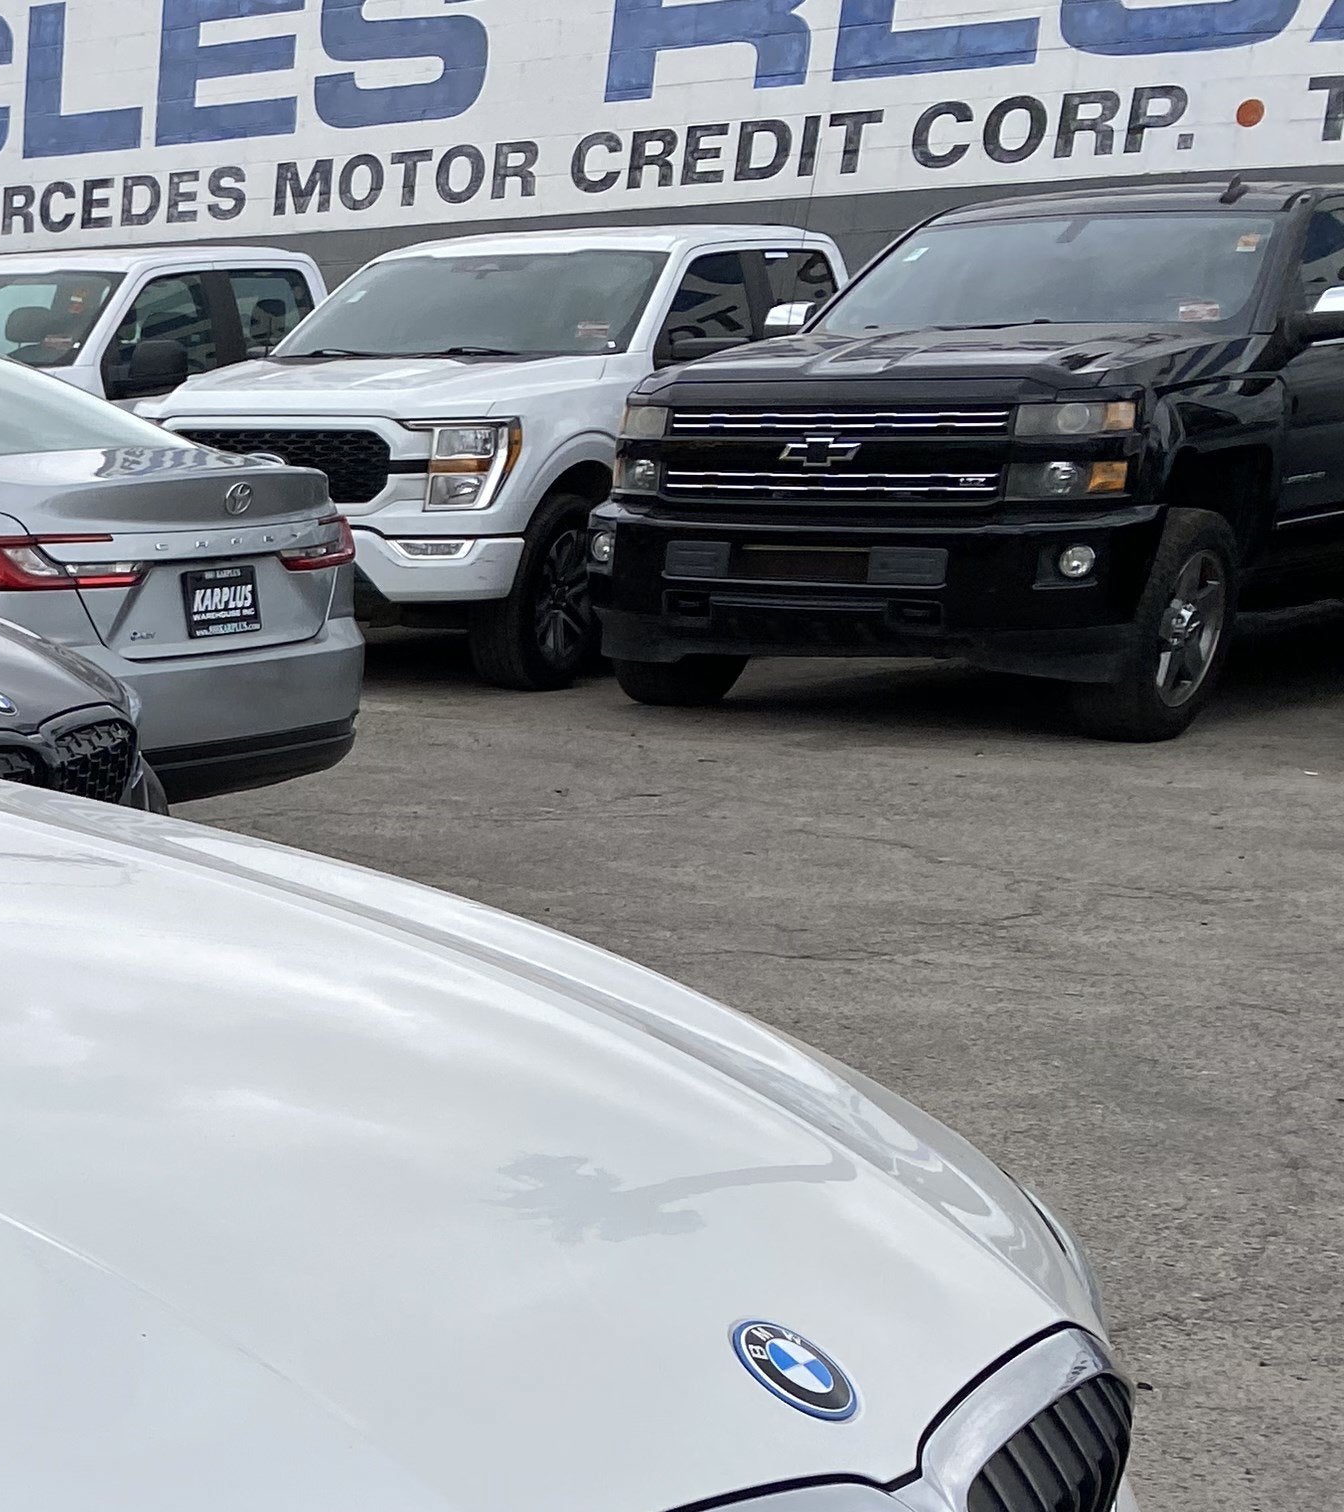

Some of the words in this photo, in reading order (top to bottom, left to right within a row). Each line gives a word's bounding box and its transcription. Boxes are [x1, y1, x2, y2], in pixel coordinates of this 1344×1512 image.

[273, 140, 539, 216] MOTOR
[570, 108, 884, 193] CREDIT
[912, 84, 1194, 170] CORP.
[193, 584, 253, 612] KARPLUS
